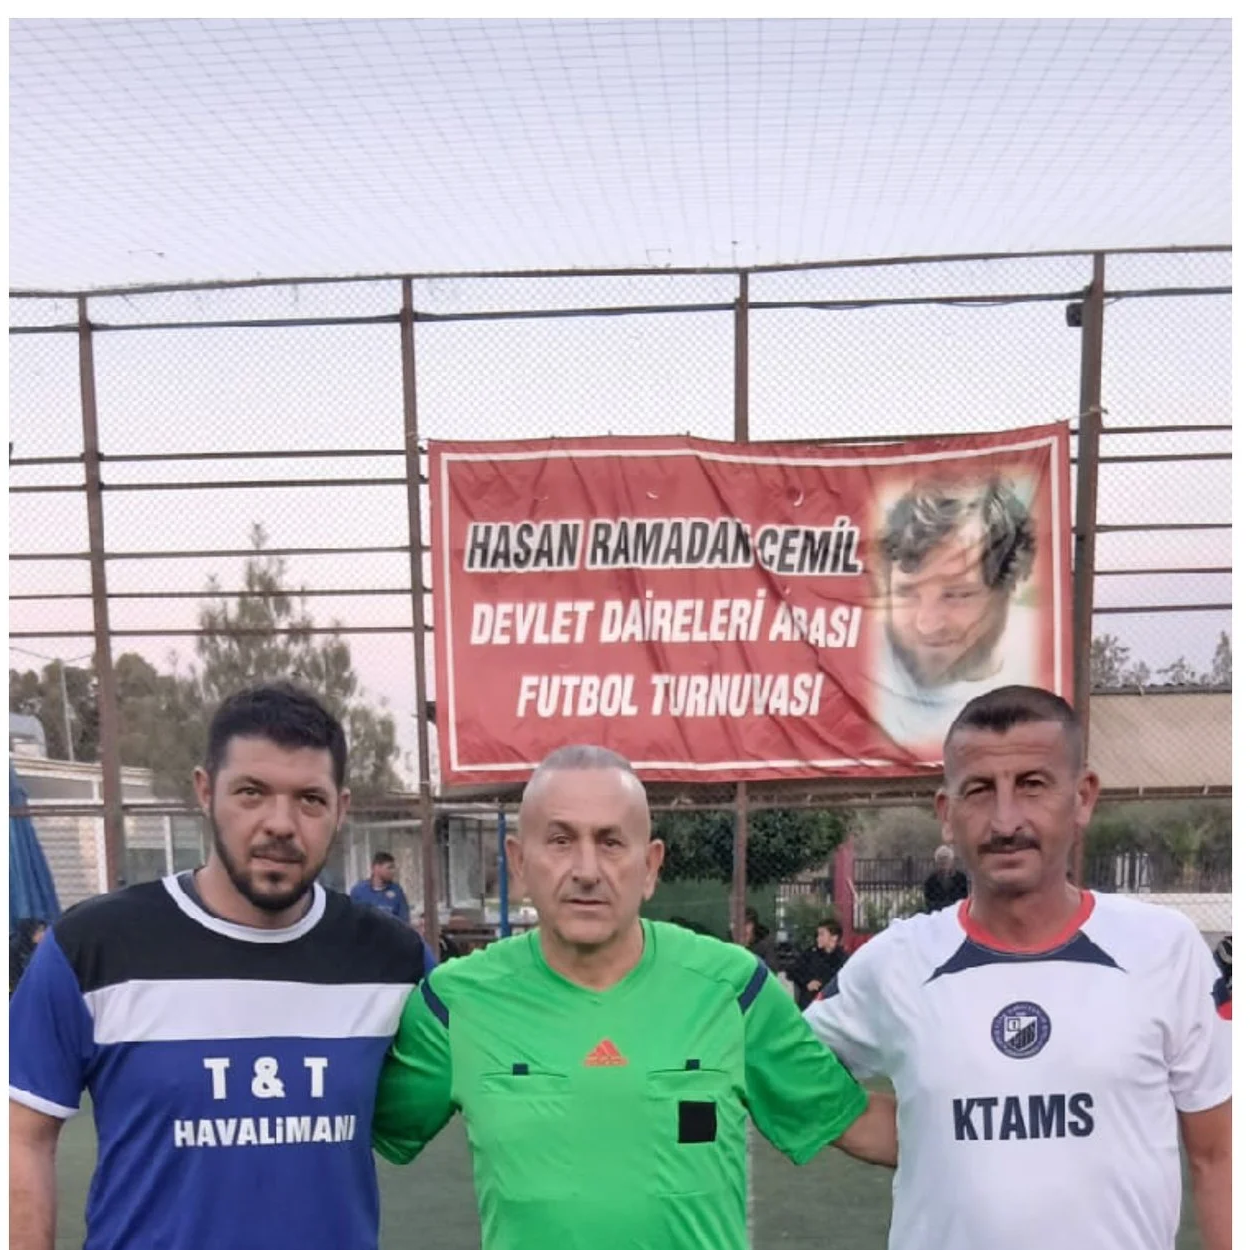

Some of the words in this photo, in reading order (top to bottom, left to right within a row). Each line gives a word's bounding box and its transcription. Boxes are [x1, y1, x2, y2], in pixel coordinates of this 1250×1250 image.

[463, 521, 581, 571] HASAN
[586, 518, 755, 569] RAMADAN
[755, 516, 863, 576] CEMİL
[470, 602, 594, 646] DEVLET
[599, 589, 767, 642] DAİRELERİ
[768, 601, 862, 648] ARASI
[517, 674, 639, 718] FUTBOL
[651, 672, 824, 717] TURNUVASI
[203, 1057, 230, 1100] T
[251, 1057, 286, 1098] &
[304, 1057, 328, 1098] T
[952, 1092, 1095, 1140] KTAMS
